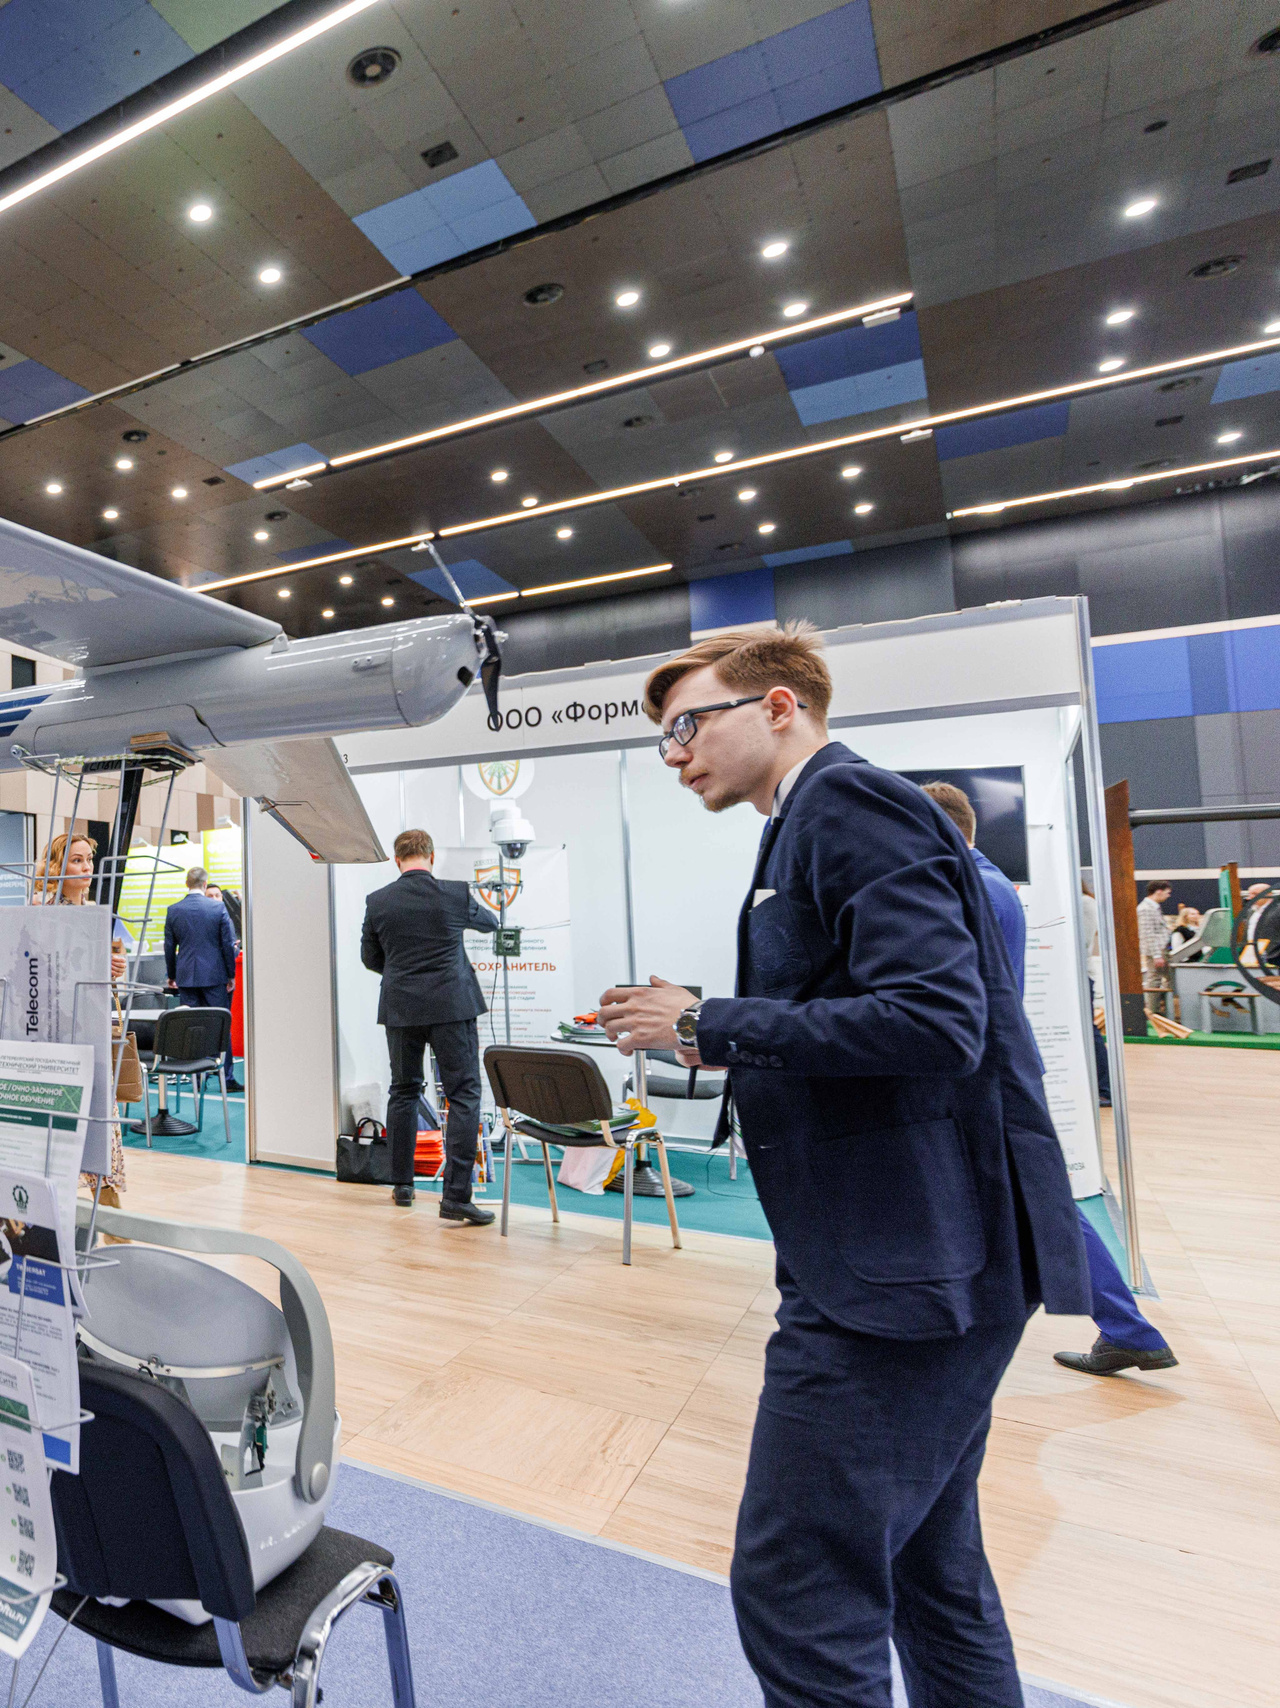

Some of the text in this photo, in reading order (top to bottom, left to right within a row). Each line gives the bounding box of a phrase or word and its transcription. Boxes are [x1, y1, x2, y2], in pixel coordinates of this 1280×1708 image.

[487, 698, 647, 732] ООО «Форм
[26, 957, 39, 1036] Telecom
[38, 1063, 79, 1073] УНИВЕРСИТЕТ
[12, 1084, 63, 1096] ОЧНО-ЗАОЧНОЕ
[20, 1094, 55, 1105] ОБУЧЕНИЕ
